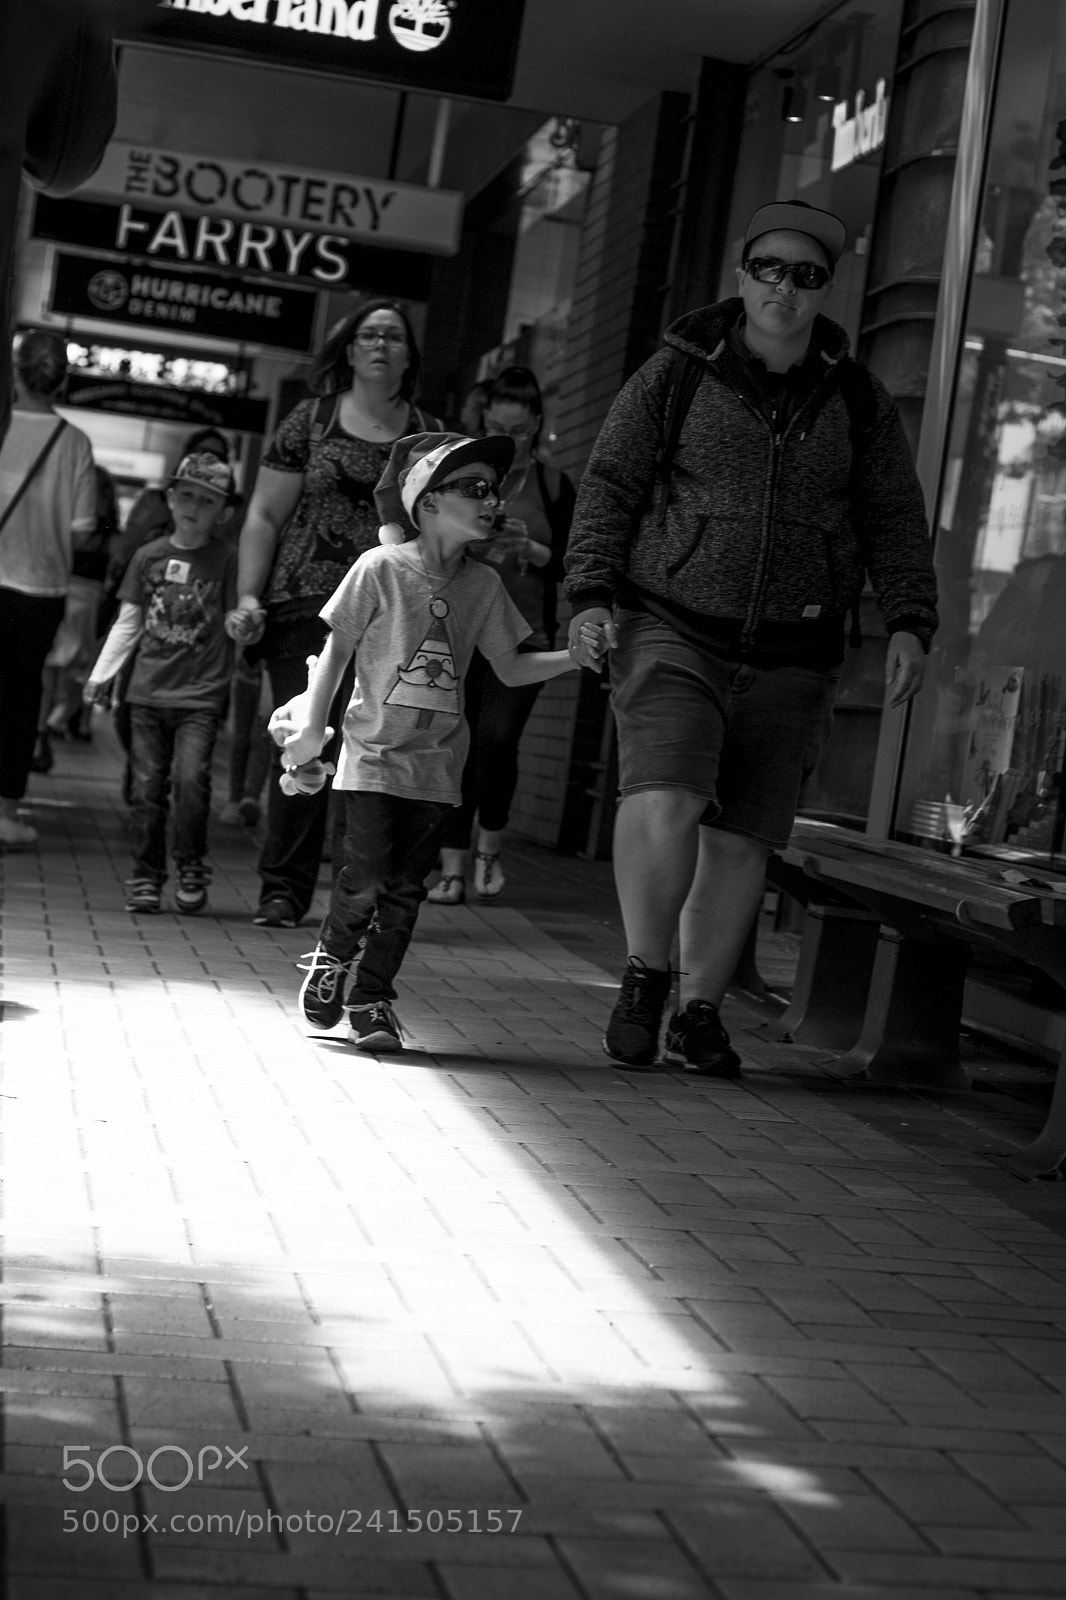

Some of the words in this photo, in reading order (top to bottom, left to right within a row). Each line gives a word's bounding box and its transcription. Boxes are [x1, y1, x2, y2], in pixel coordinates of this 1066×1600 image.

[125, 151, 150, 194] THE
[152, 155, 395, 232] BOOTERY
[114, 204, 350, 282] FARRYS
[127, 297, 197, 324] DENIM
[130, 274, 283, 318] HURRICANE
